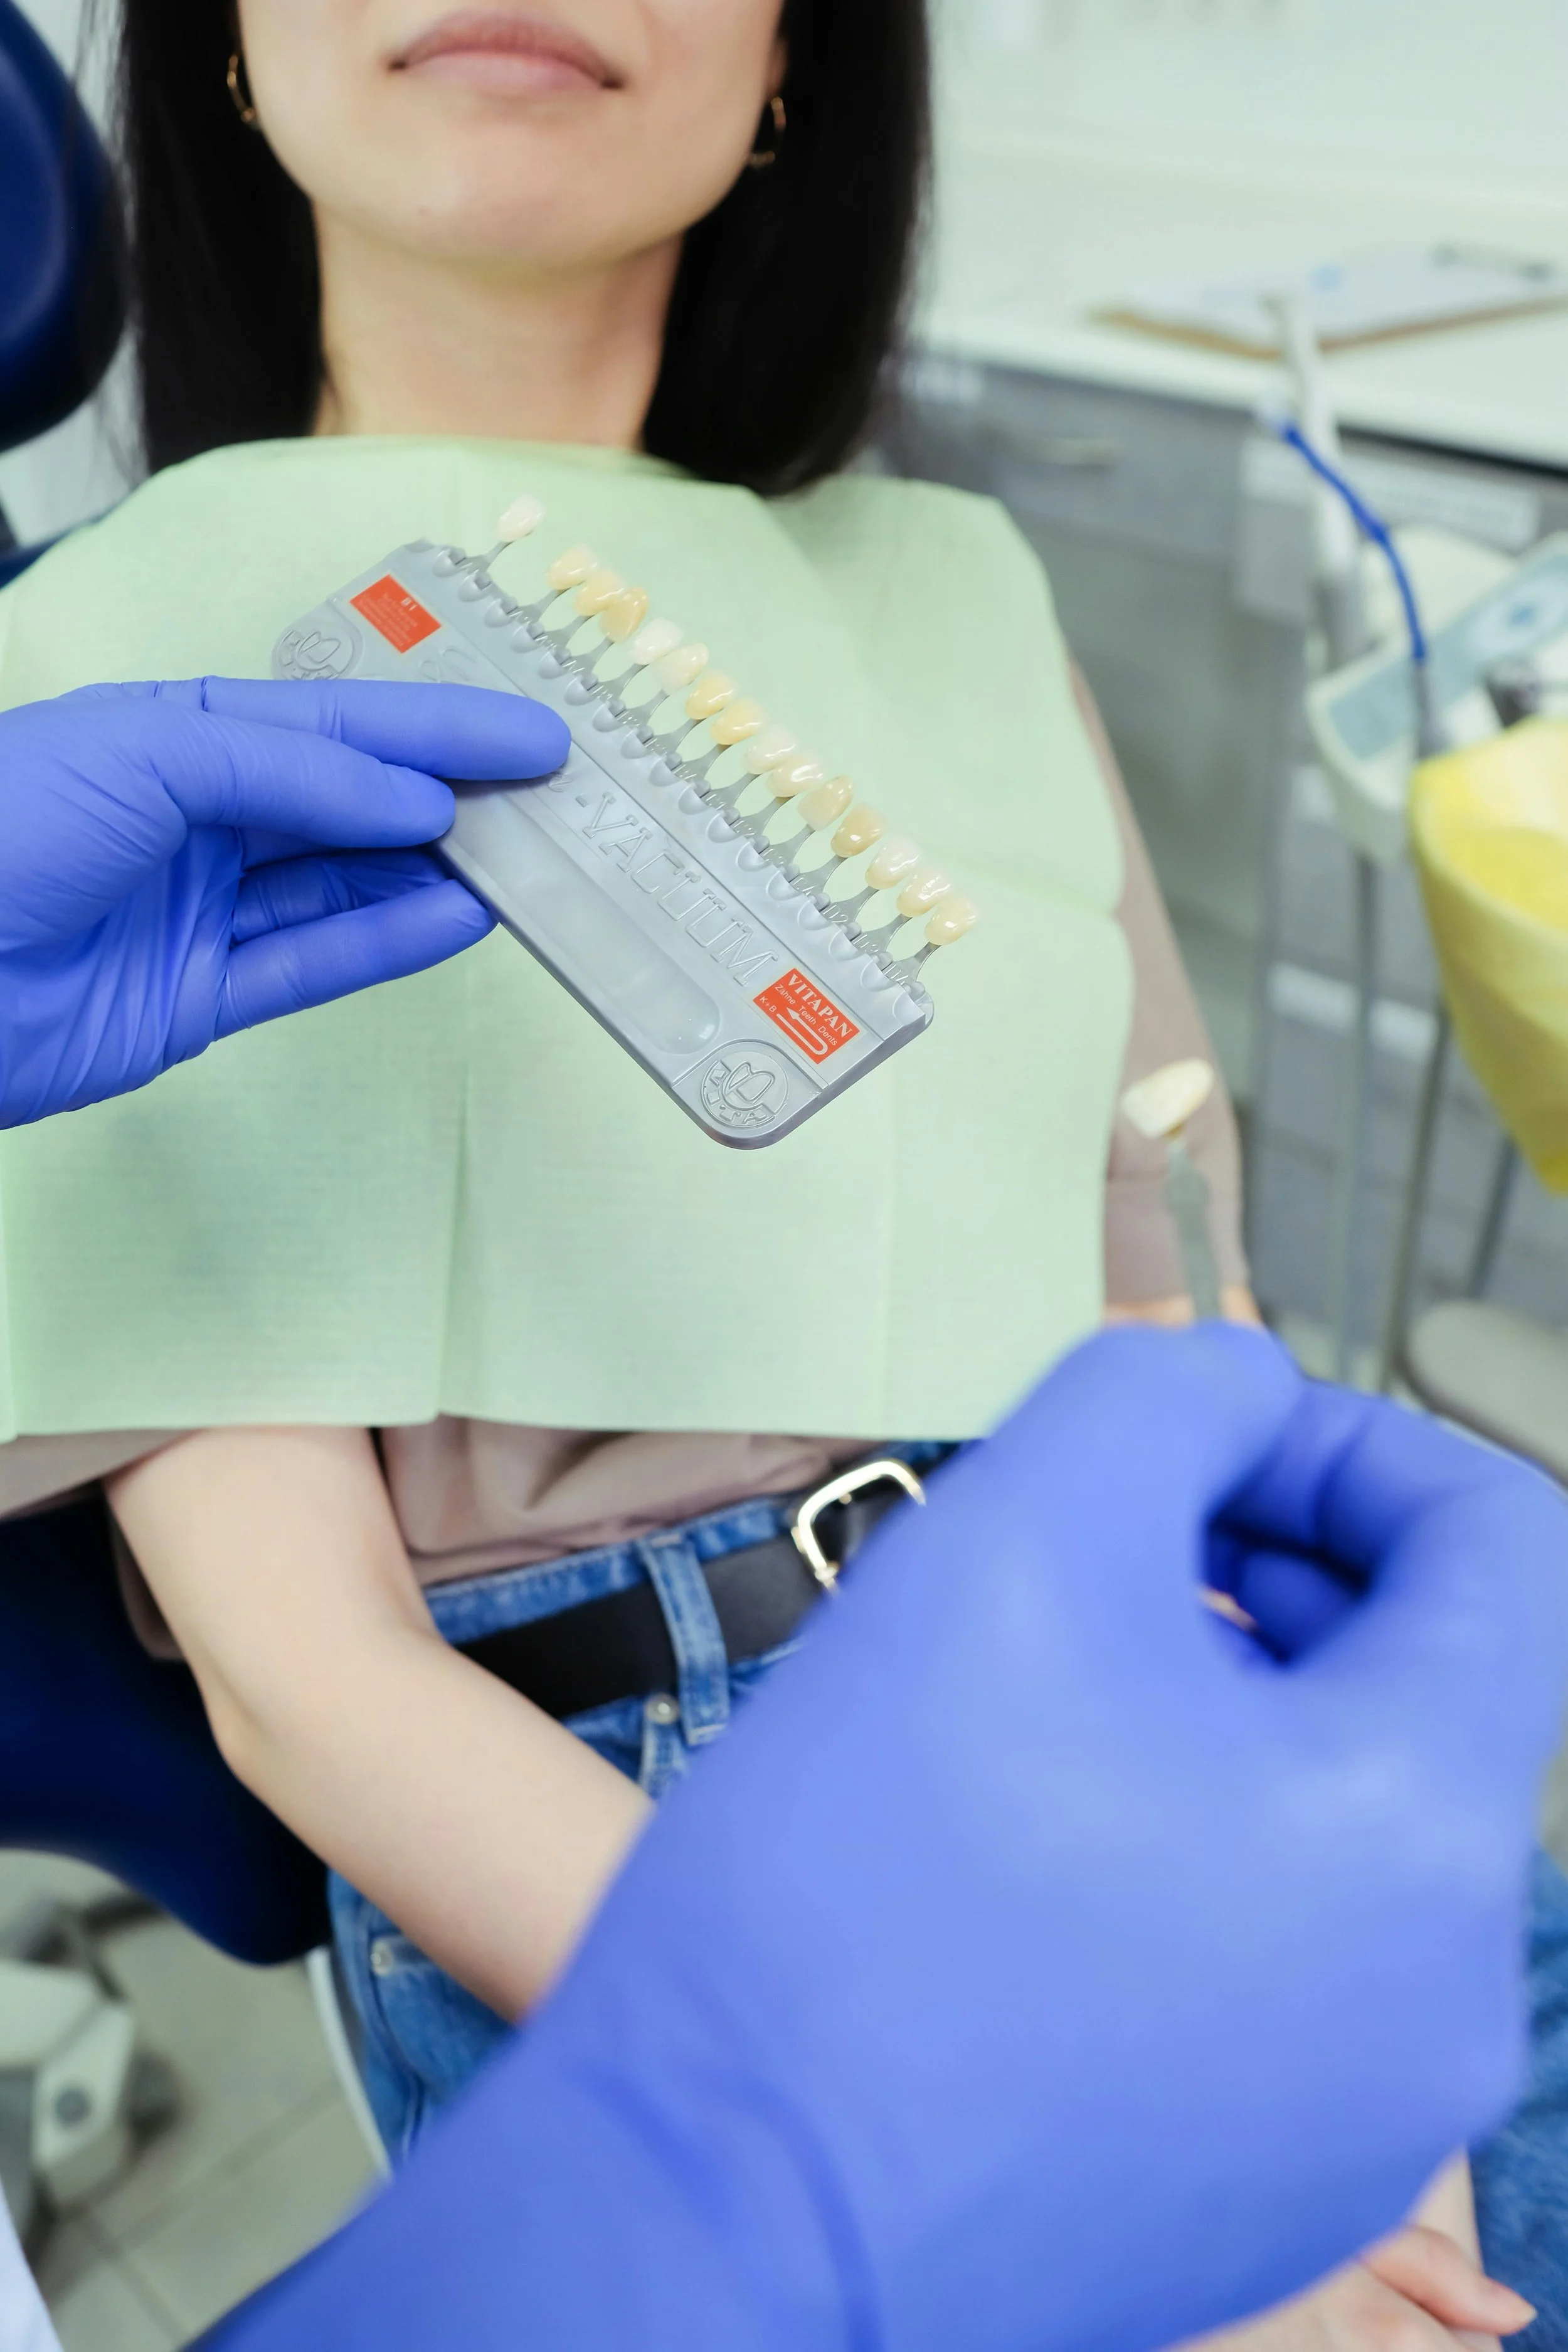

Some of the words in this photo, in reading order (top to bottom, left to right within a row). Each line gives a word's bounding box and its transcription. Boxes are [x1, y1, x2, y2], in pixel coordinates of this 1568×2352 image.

[823, 905, 849, 923] D2
[884, 964, 909, 985] D4
[774, 983, 797, 1005] Zähne
[798, 1006, 817, 1026] Teeth
[817, 1025, 838, 1047] Dents
[786, 973, 853, 1039] VITAPAN
